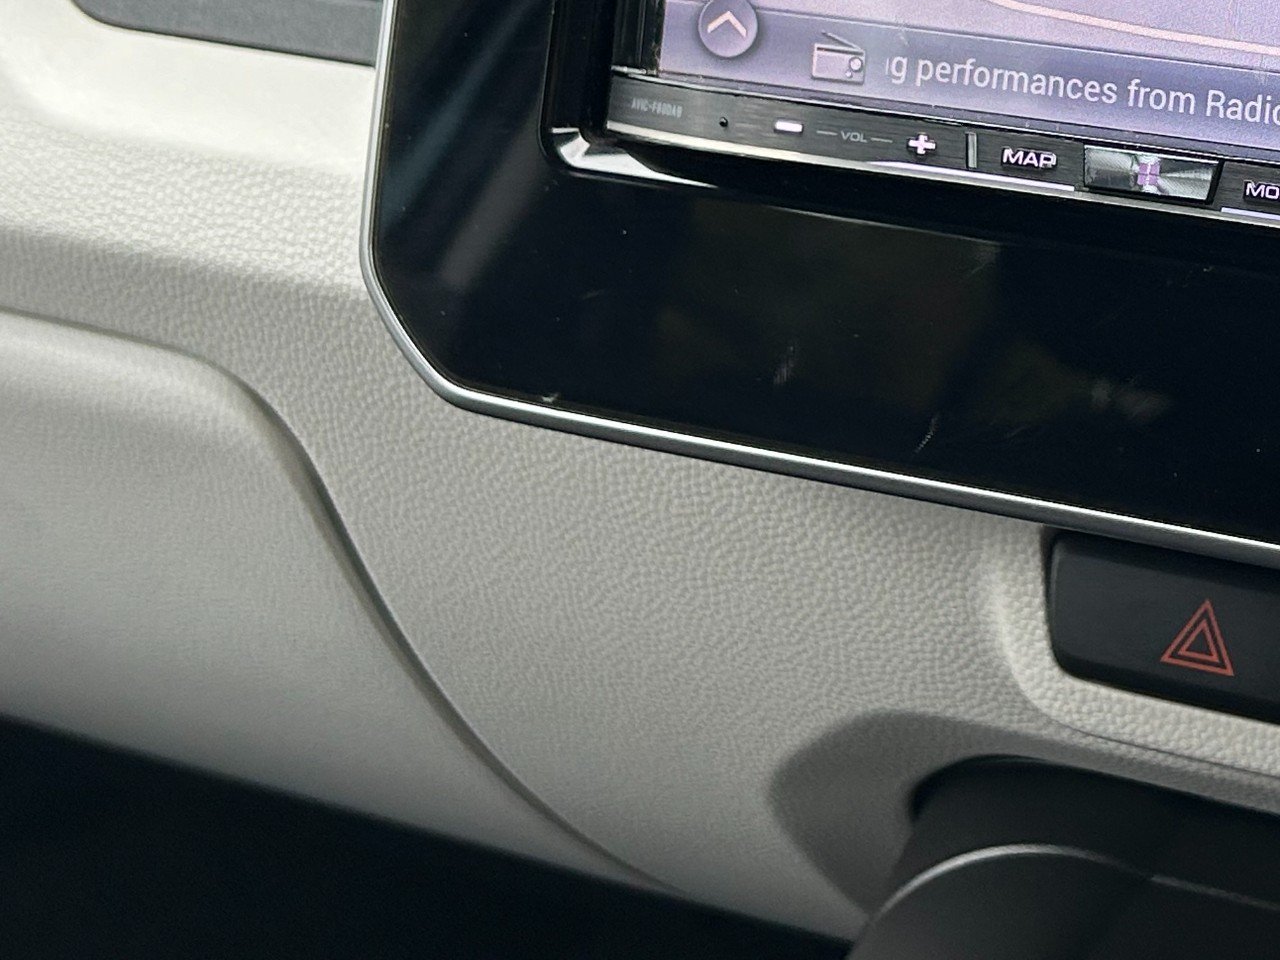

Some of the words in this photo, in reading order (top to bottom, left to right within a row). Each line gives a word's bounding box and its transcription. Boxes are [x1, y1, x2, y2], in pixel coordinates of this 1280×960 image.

[915, 57, 1118, 105] performances
[1127, 78, 1195, 115] from
[841, 131, 867, 143] VOL
[1003, 147, 1057, 168] MAP
